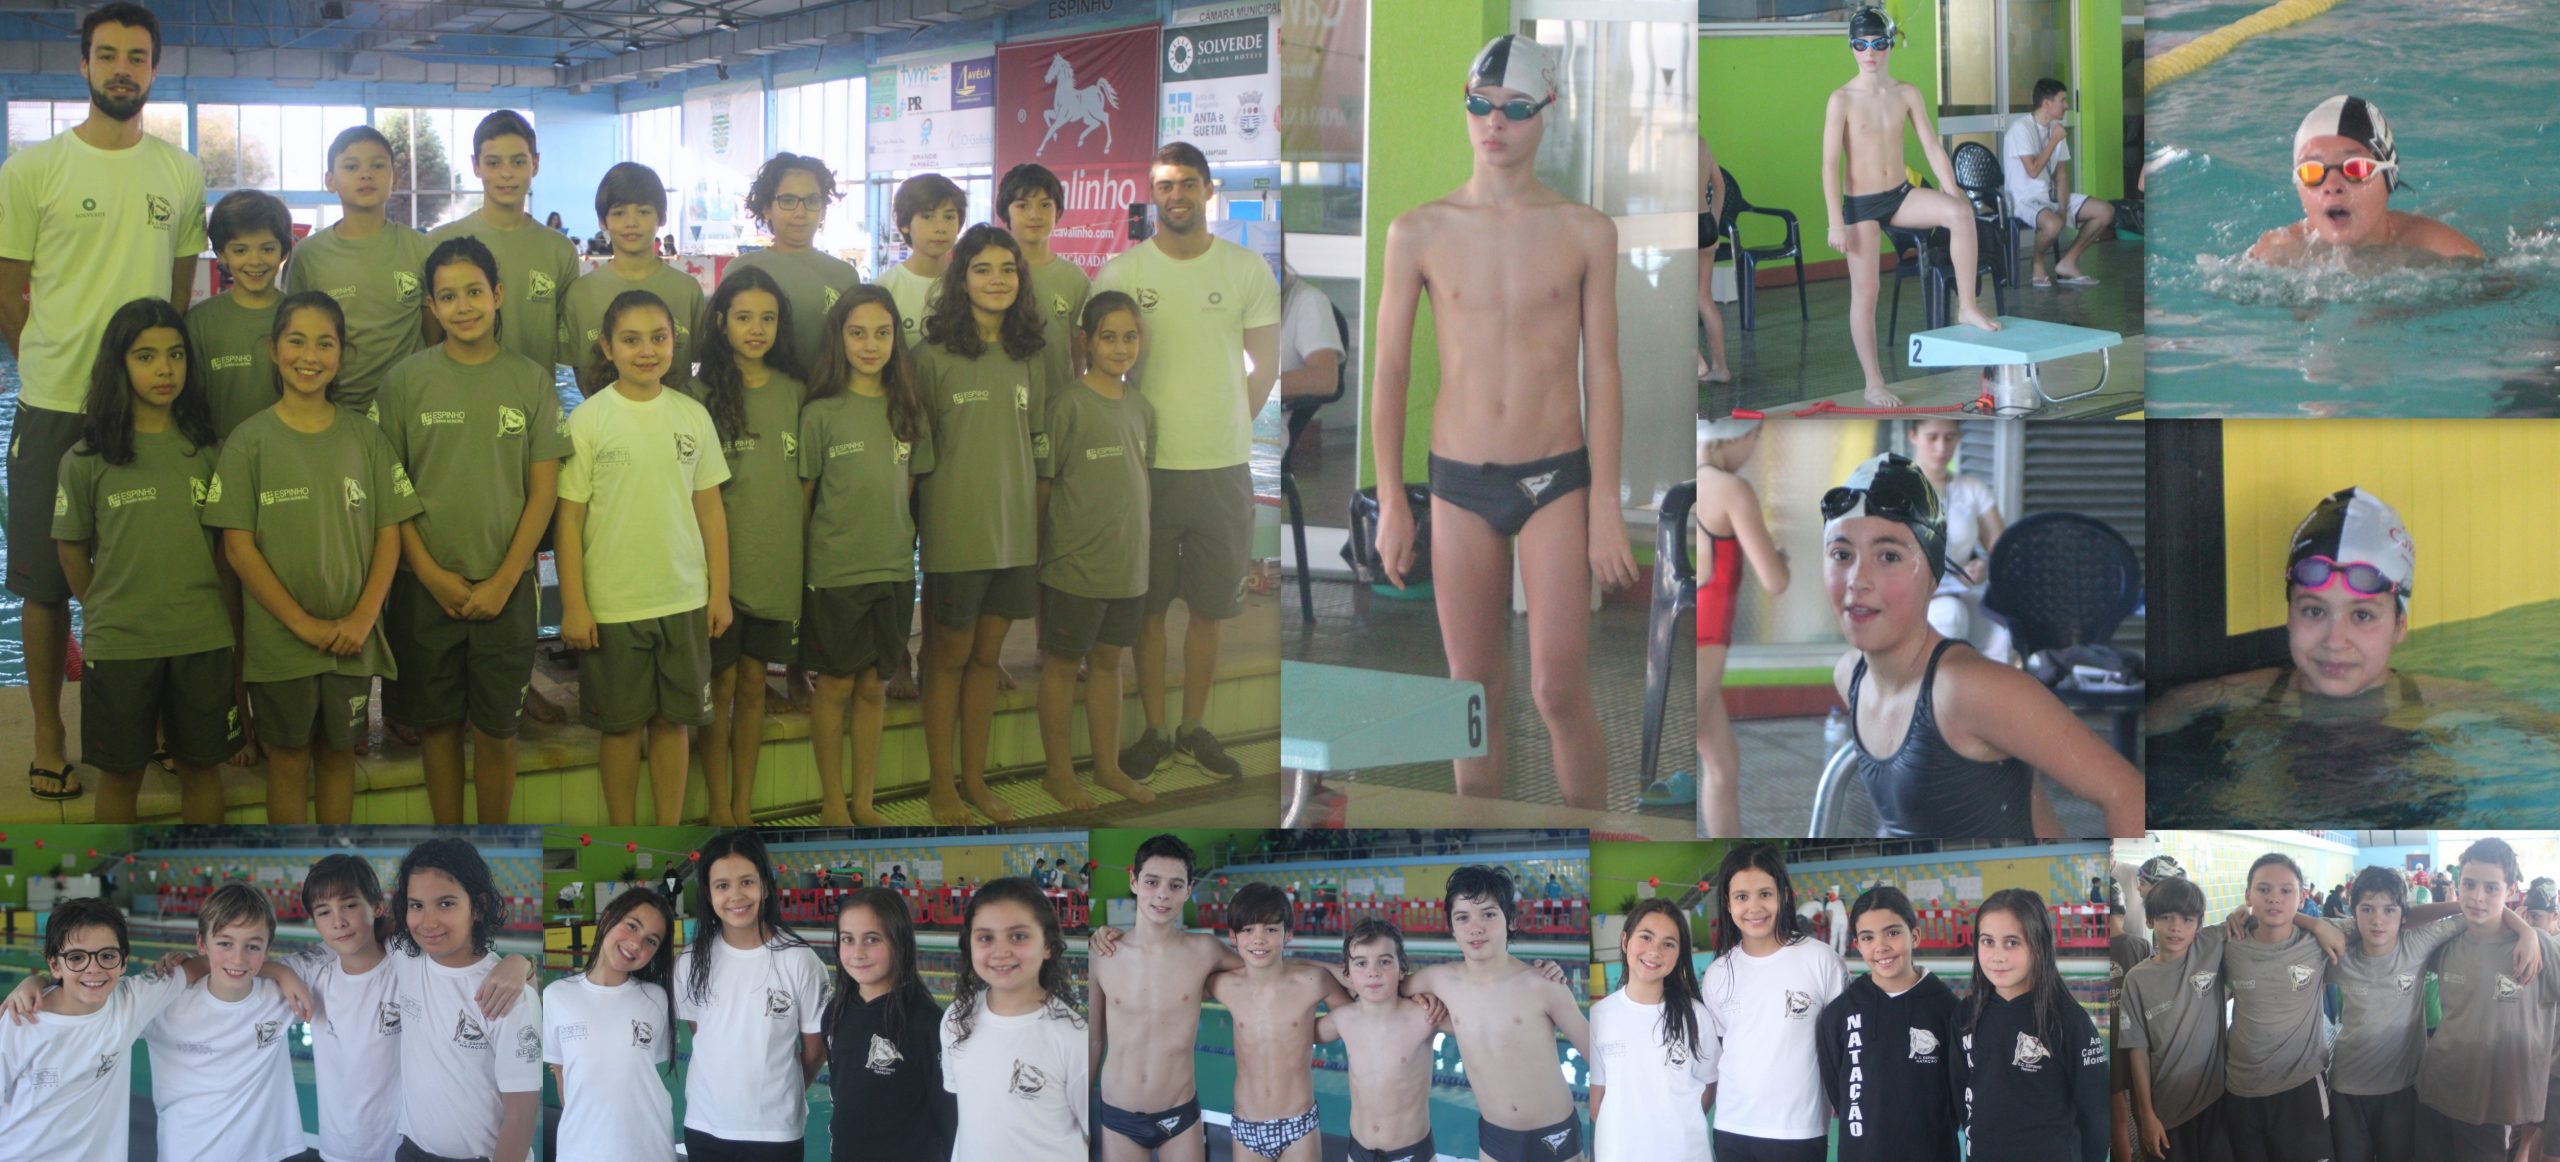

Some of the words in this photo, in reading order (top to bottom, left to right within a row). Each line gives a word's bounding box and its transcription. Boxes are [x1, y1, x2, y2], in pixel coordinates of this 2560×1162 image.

[1198, 34, 1263, 56] SOLVERDE
[907, 96, 922, 111] PR
[1193, 112, 1217, 124] ANTA
[1193, 124, 1227, 137] GUETIM
[1912, 338, 1923, 364] 2
[221, 354, 252, 365] ESPINHO
[433, 411, 465, 419] ESPINHO
[120, 487, 157, 500] ESPINHO
[274, 487, 309, 499] ESPINHO
[1468, 694, 1482, 749] 6
[1847, 1013, 1863, 1137] NATAÇÃO
